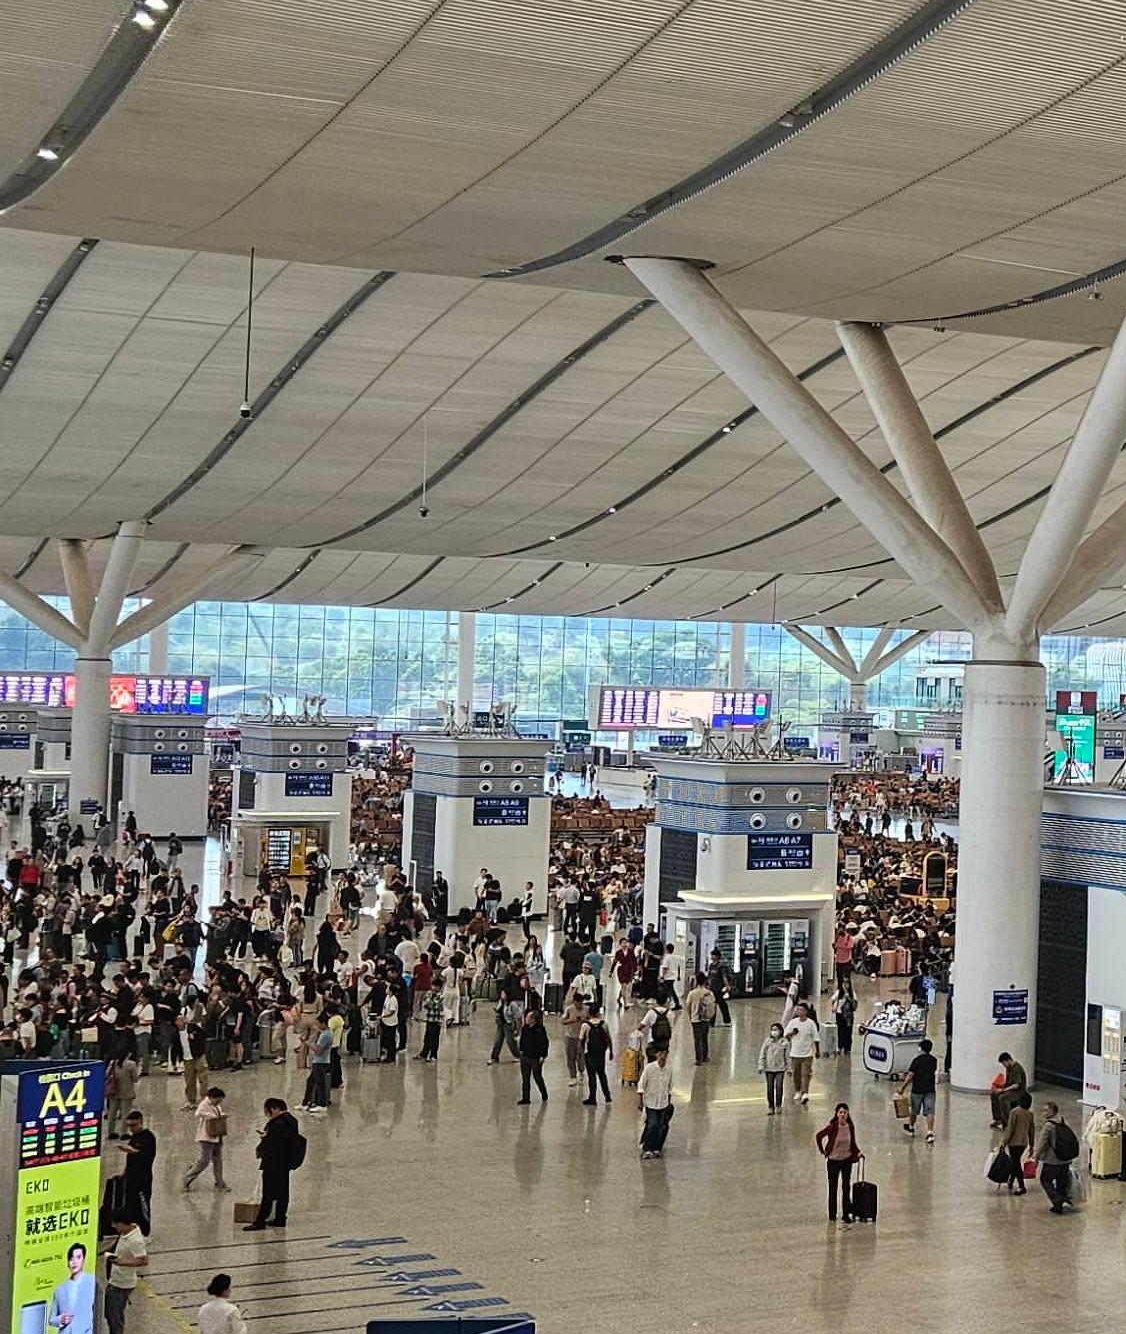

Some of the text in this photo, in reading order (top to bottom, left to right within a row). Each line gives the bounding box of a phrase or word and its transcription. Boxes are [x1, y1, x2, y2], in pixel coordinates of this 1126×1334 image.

[39, 1079, 87, 1118] A4
[26, 1179, 49, 1194] EKO
[25, 1208, 90, 1236] 就选EKO
